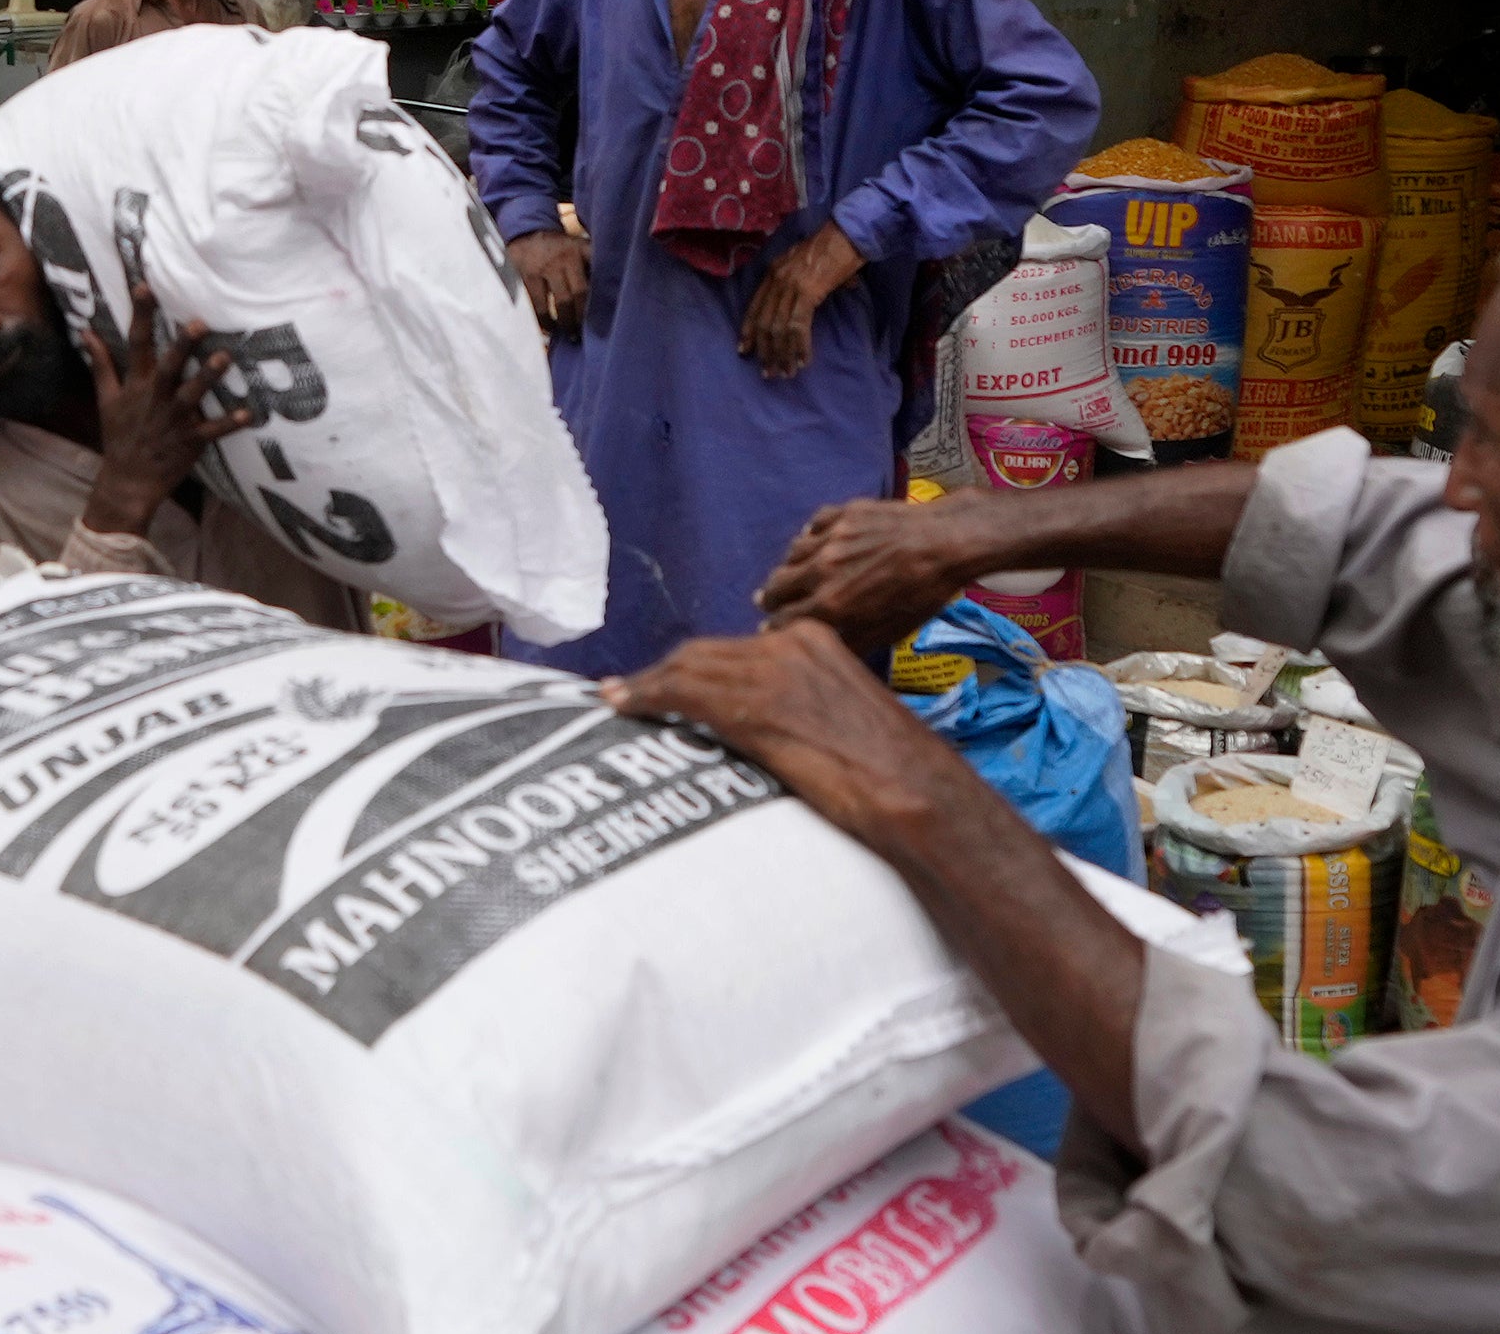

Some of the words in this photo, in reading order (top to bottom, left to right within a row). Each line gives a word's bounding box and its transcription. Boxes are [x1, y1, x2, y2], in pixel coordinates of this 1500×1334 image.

[1125, 200, 1199, 248] VIP
[1255, 222, 1312, 244] HANA
[1313, 222, 1358, 244] DAAL
[1108, 268, 1214, 310] YDERABAD
[1010, 311, 1055, 326] 50.000
[1110, 316, 1210, 335] DUSTRIES
[1010, 330, 1075, 349] DECEMBER
[1275, 320, 1313, 342] JB
[1167, 343, 1216, 366] 999
[976, 367, 1063, 392] EXPORT
[1003, 454, 1052, 469] DULHAN
[511, 757, 772, 896] SHEIKHUPU
[278, 761, 628, 998] MAHNOOR
[600, 728, 725, 789] RIC
